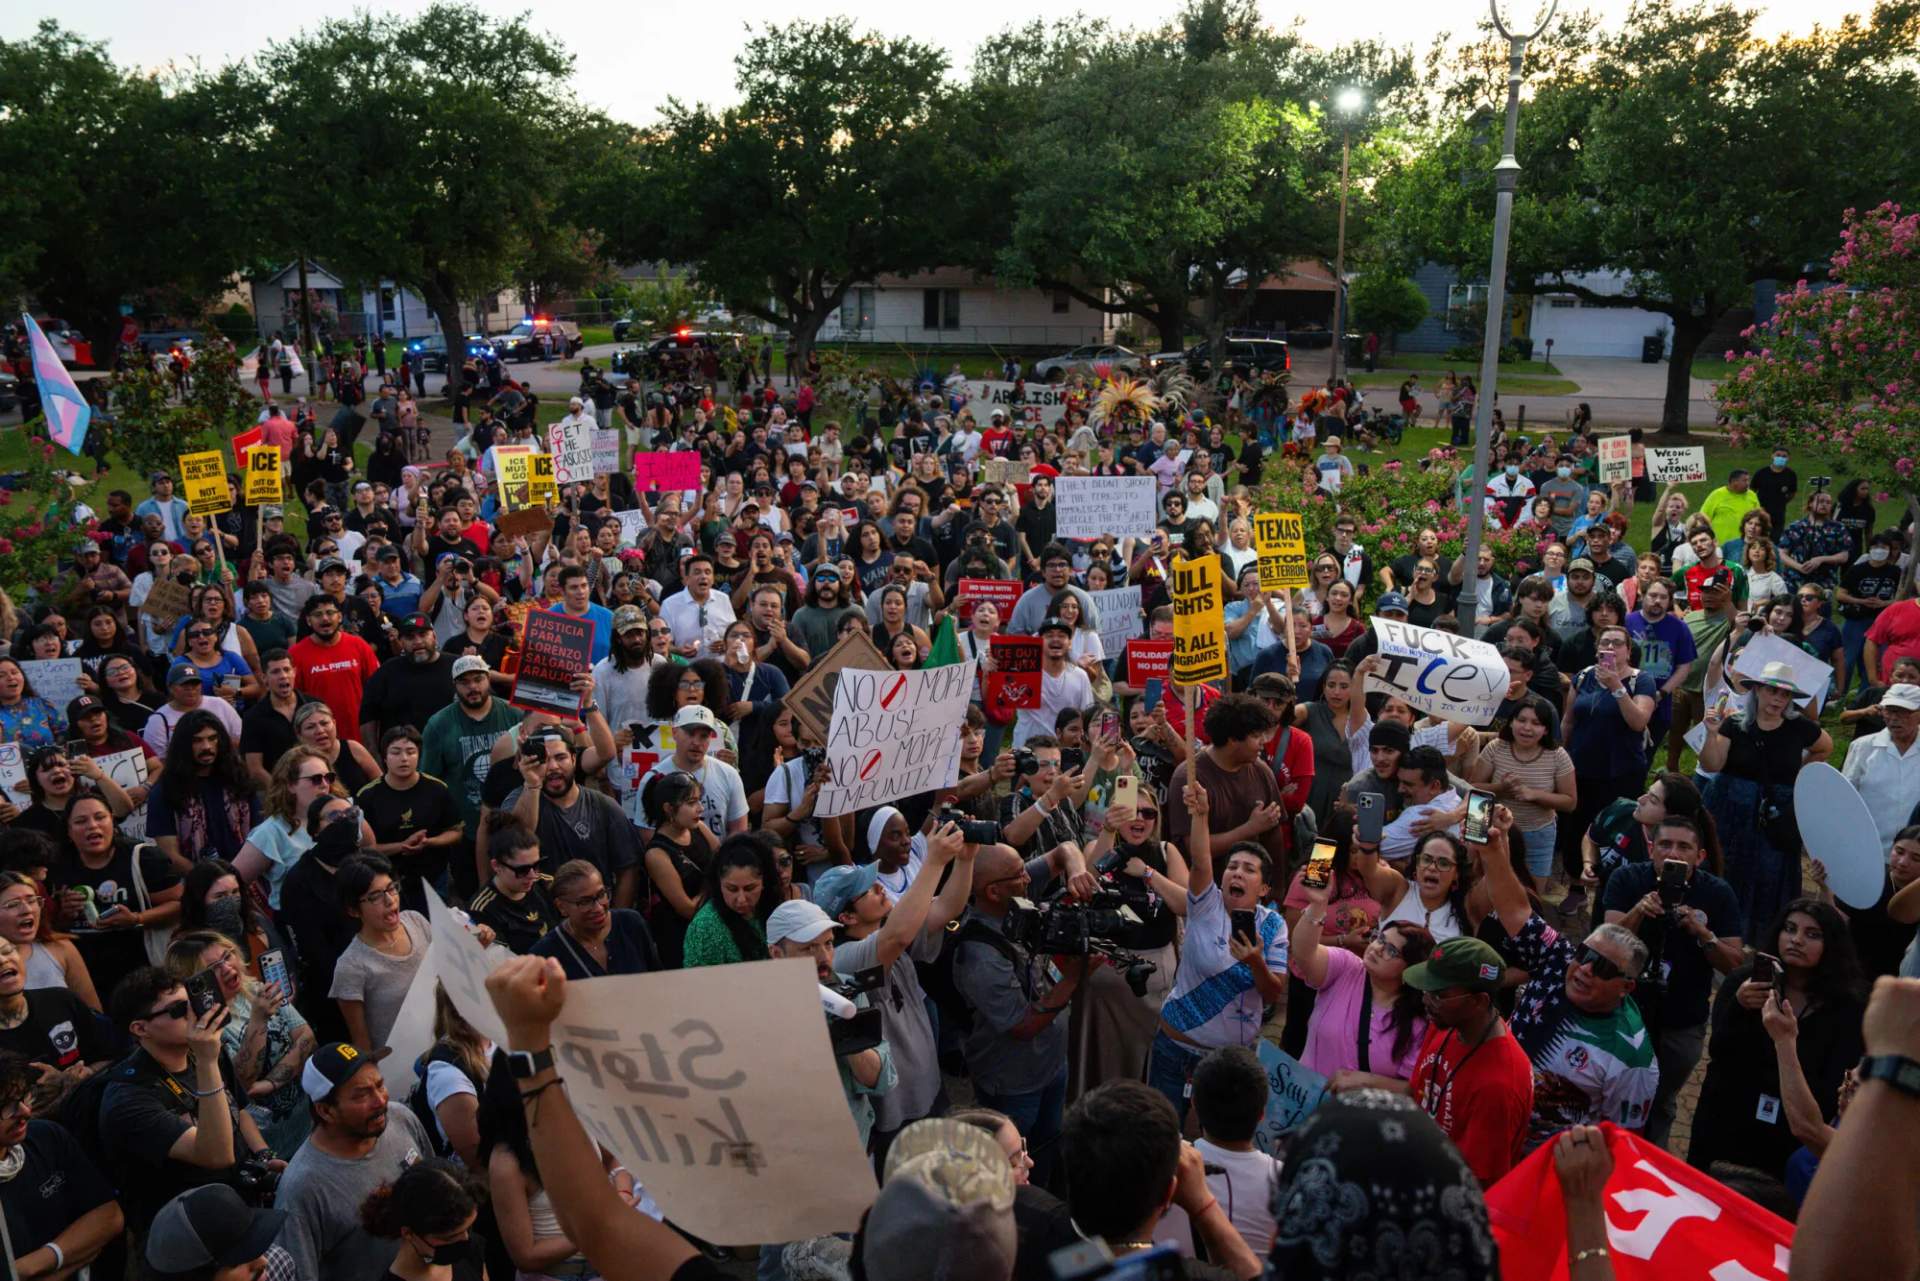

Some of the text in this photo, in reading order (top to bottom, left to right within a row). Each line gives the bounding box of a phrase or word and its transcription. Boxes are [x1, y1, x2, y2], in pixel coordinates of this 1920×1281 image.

[252, 452, 277, 471] ICE
[1654, 449, 1691, 457] WRONG
[187, 463, 220, 474] ARE THE
[535, 458, 553, 476] ICE
[1658, 463, 1699, 473] WRONG!
[199, 487, 216, 497] NOT
[1112, 503, 1129, 512] THE
[1256, 519, 1301, 541] TEXAS
[1259, 555, 1304, 565] STOP
[1260, 565, 1306, 579] ICE TERROR
[530, 628, 562, 644] PARA
[532, 617, 585, 638] JUSTICIA
[527, 640, 582, 661] LORENZO
[1190, 632, 1218, 652] ALL
[1384, 623, 1471, 660] FUCK
[1643, 643, 1659, 662] 11
[525, 653, 583, 673] SALGADO
[1137, 662, 1150, 670] NO
[523, 666, 573, 683] ARAUJO
[834, 665, 972, 713] NO MORE
[826, 754, 857, 787] NO
[892, 721, 956, 769] MORE
